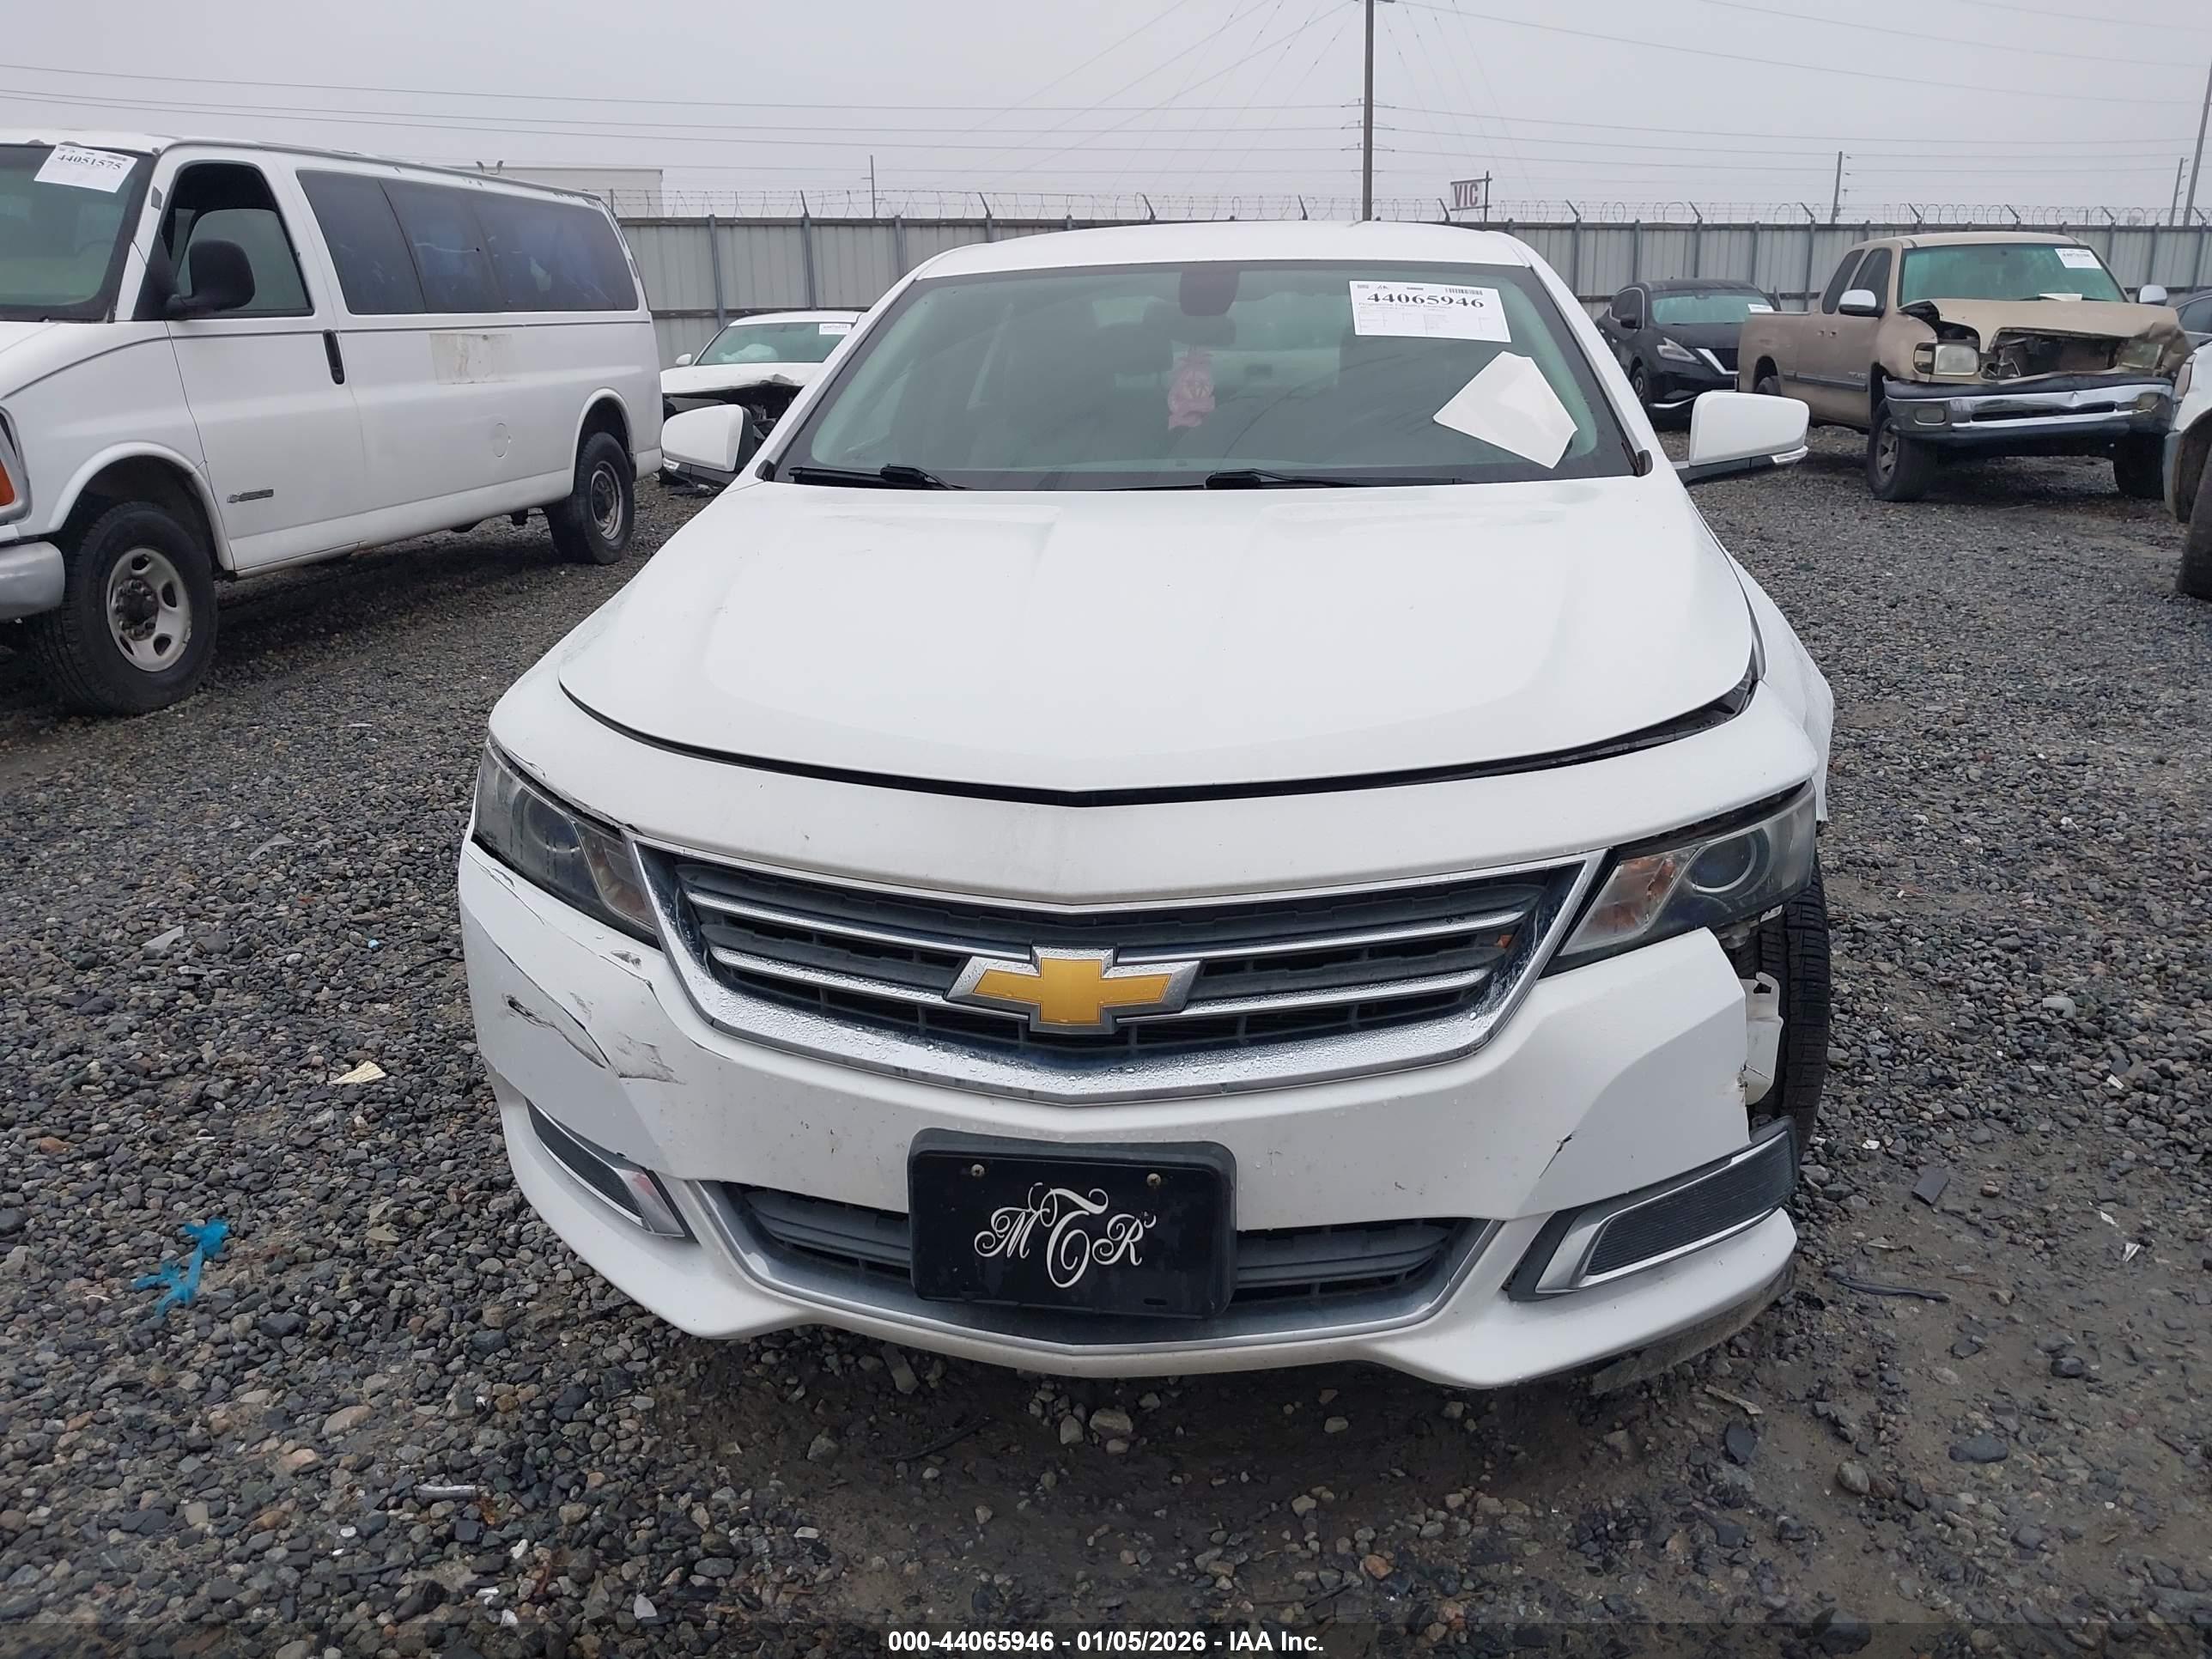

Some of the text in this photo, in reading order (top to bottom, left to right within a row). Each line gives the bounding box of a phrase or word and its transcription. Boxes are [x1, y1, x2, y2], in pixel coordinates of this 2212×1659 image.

[58, 154, 123, 170] 44051575
[1454, 183, 1479, 207] VIC
[1367, 293, 1485, 308] 44065946
